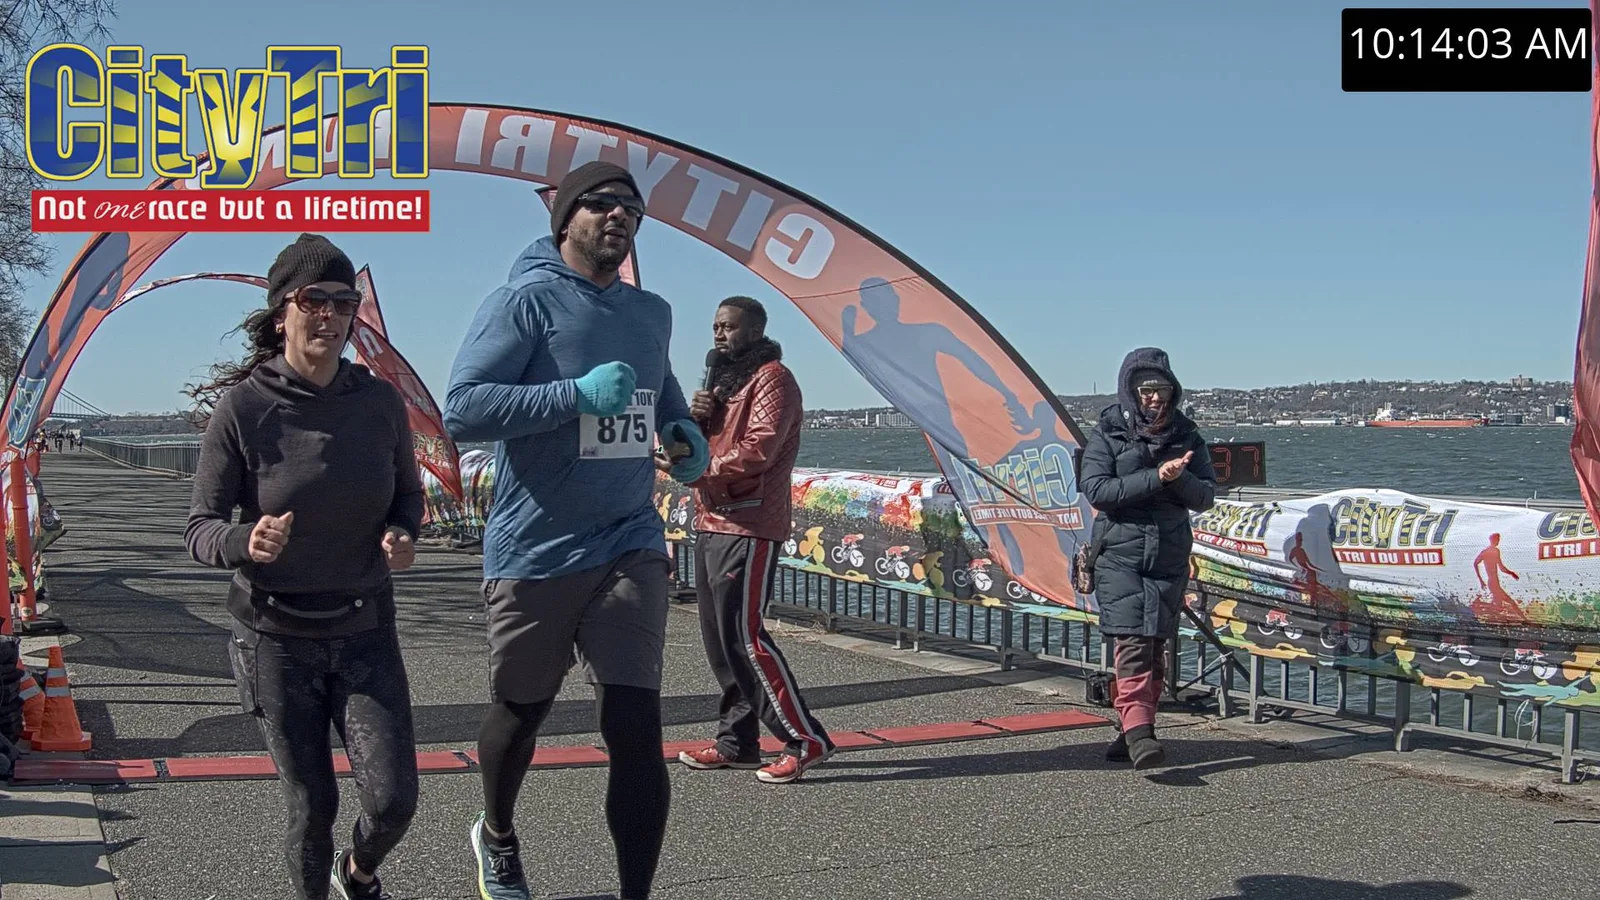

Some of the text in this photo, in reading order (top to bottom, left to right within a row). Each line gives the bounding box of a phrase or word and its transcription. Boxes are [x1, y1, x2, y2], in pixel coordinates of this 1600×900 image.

[597, 413, 648, 445] 875
[1553, 542, 1582, 557] TRI
[1342, 551, 1366, 563] TRI
[1412, 551, 1440, 564] DID
